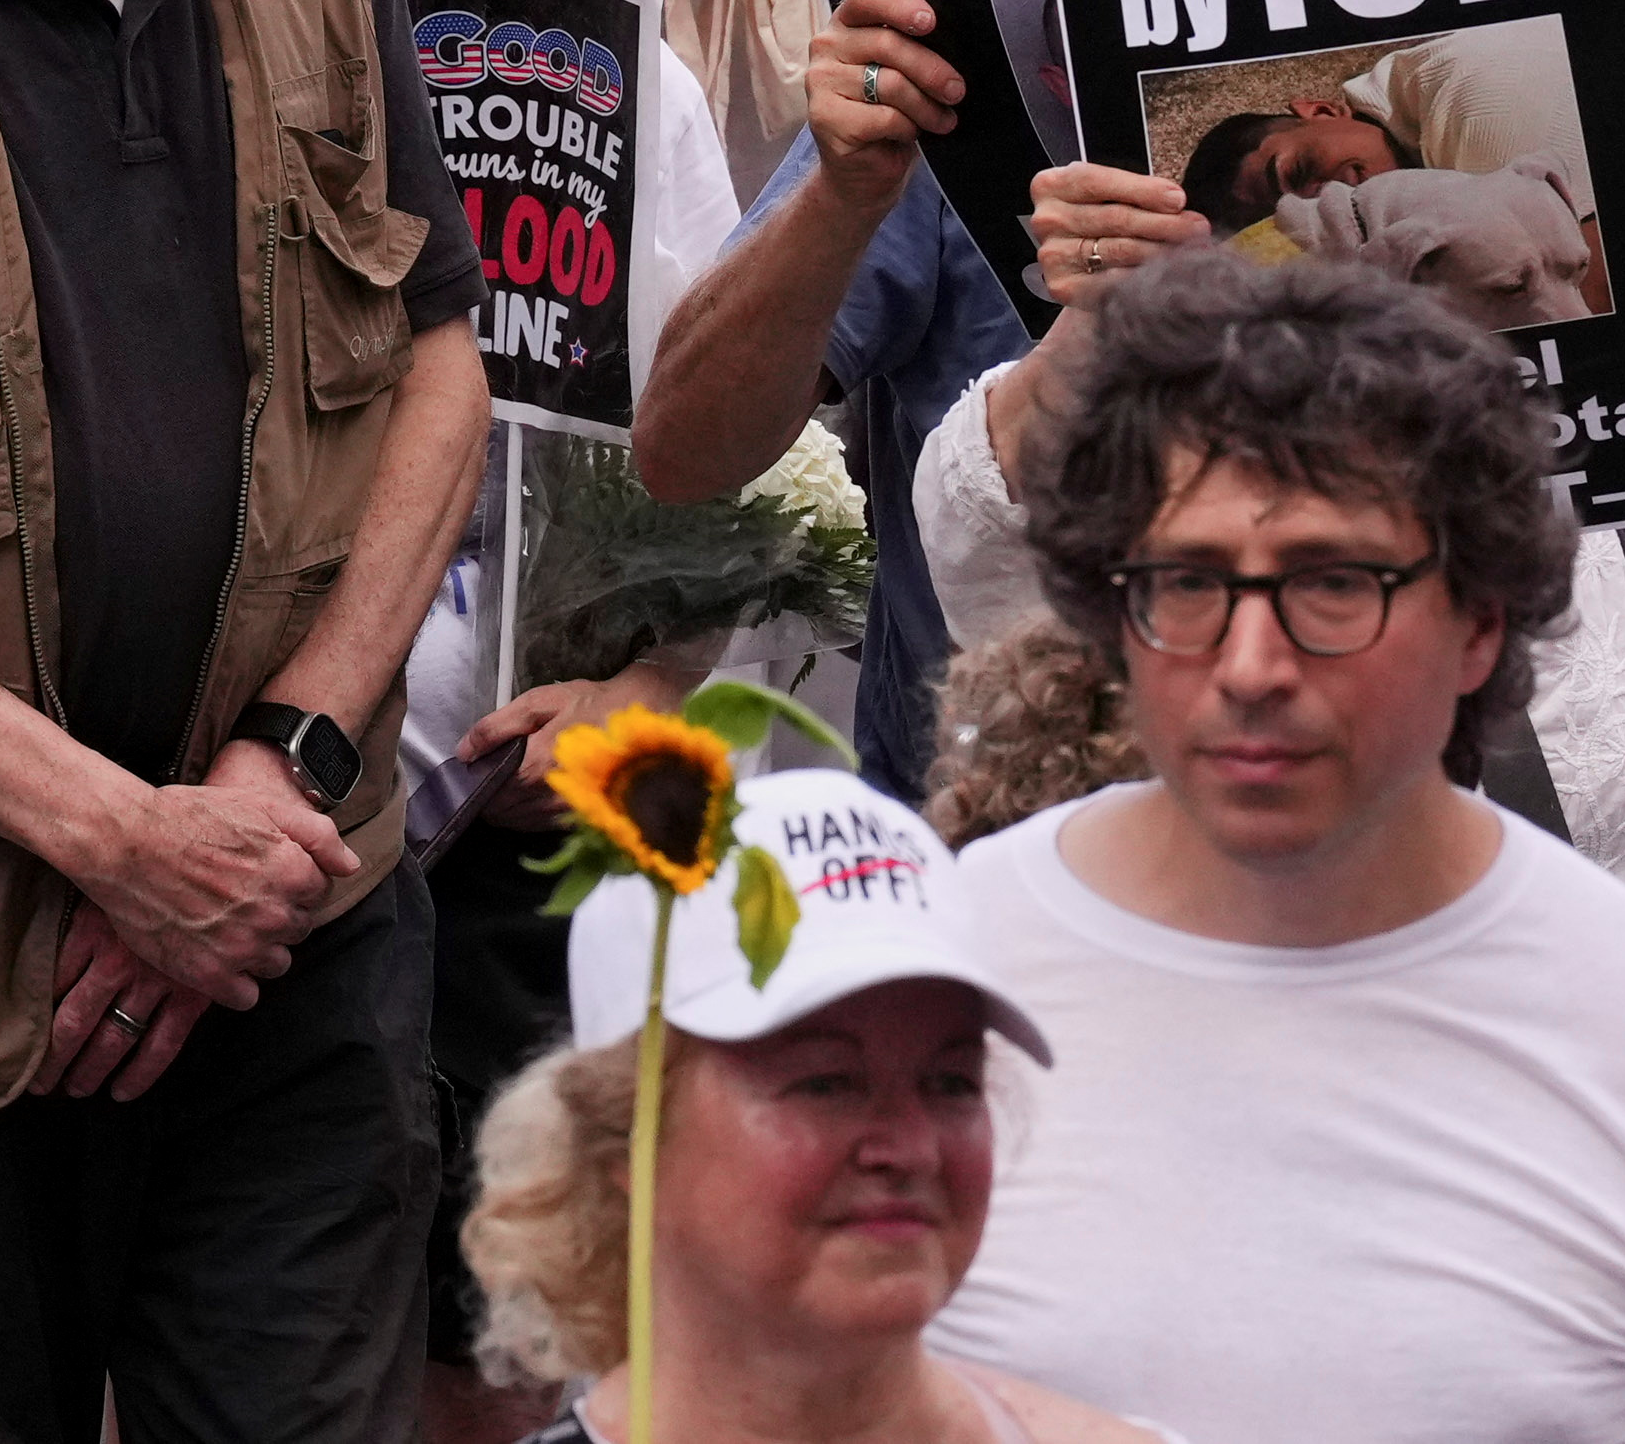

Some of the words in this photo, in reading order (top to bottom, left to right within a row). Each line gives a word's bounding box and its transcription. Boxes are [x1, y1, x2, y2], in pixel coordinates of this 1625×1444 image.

[412, 9, 625, 117] GOOD
[430, 93, 625, 182] ROUBLE
[530, 148, 565, 190] in
[566, 171, 610, 230] my
[462, 187, 617, 308] LOOD
